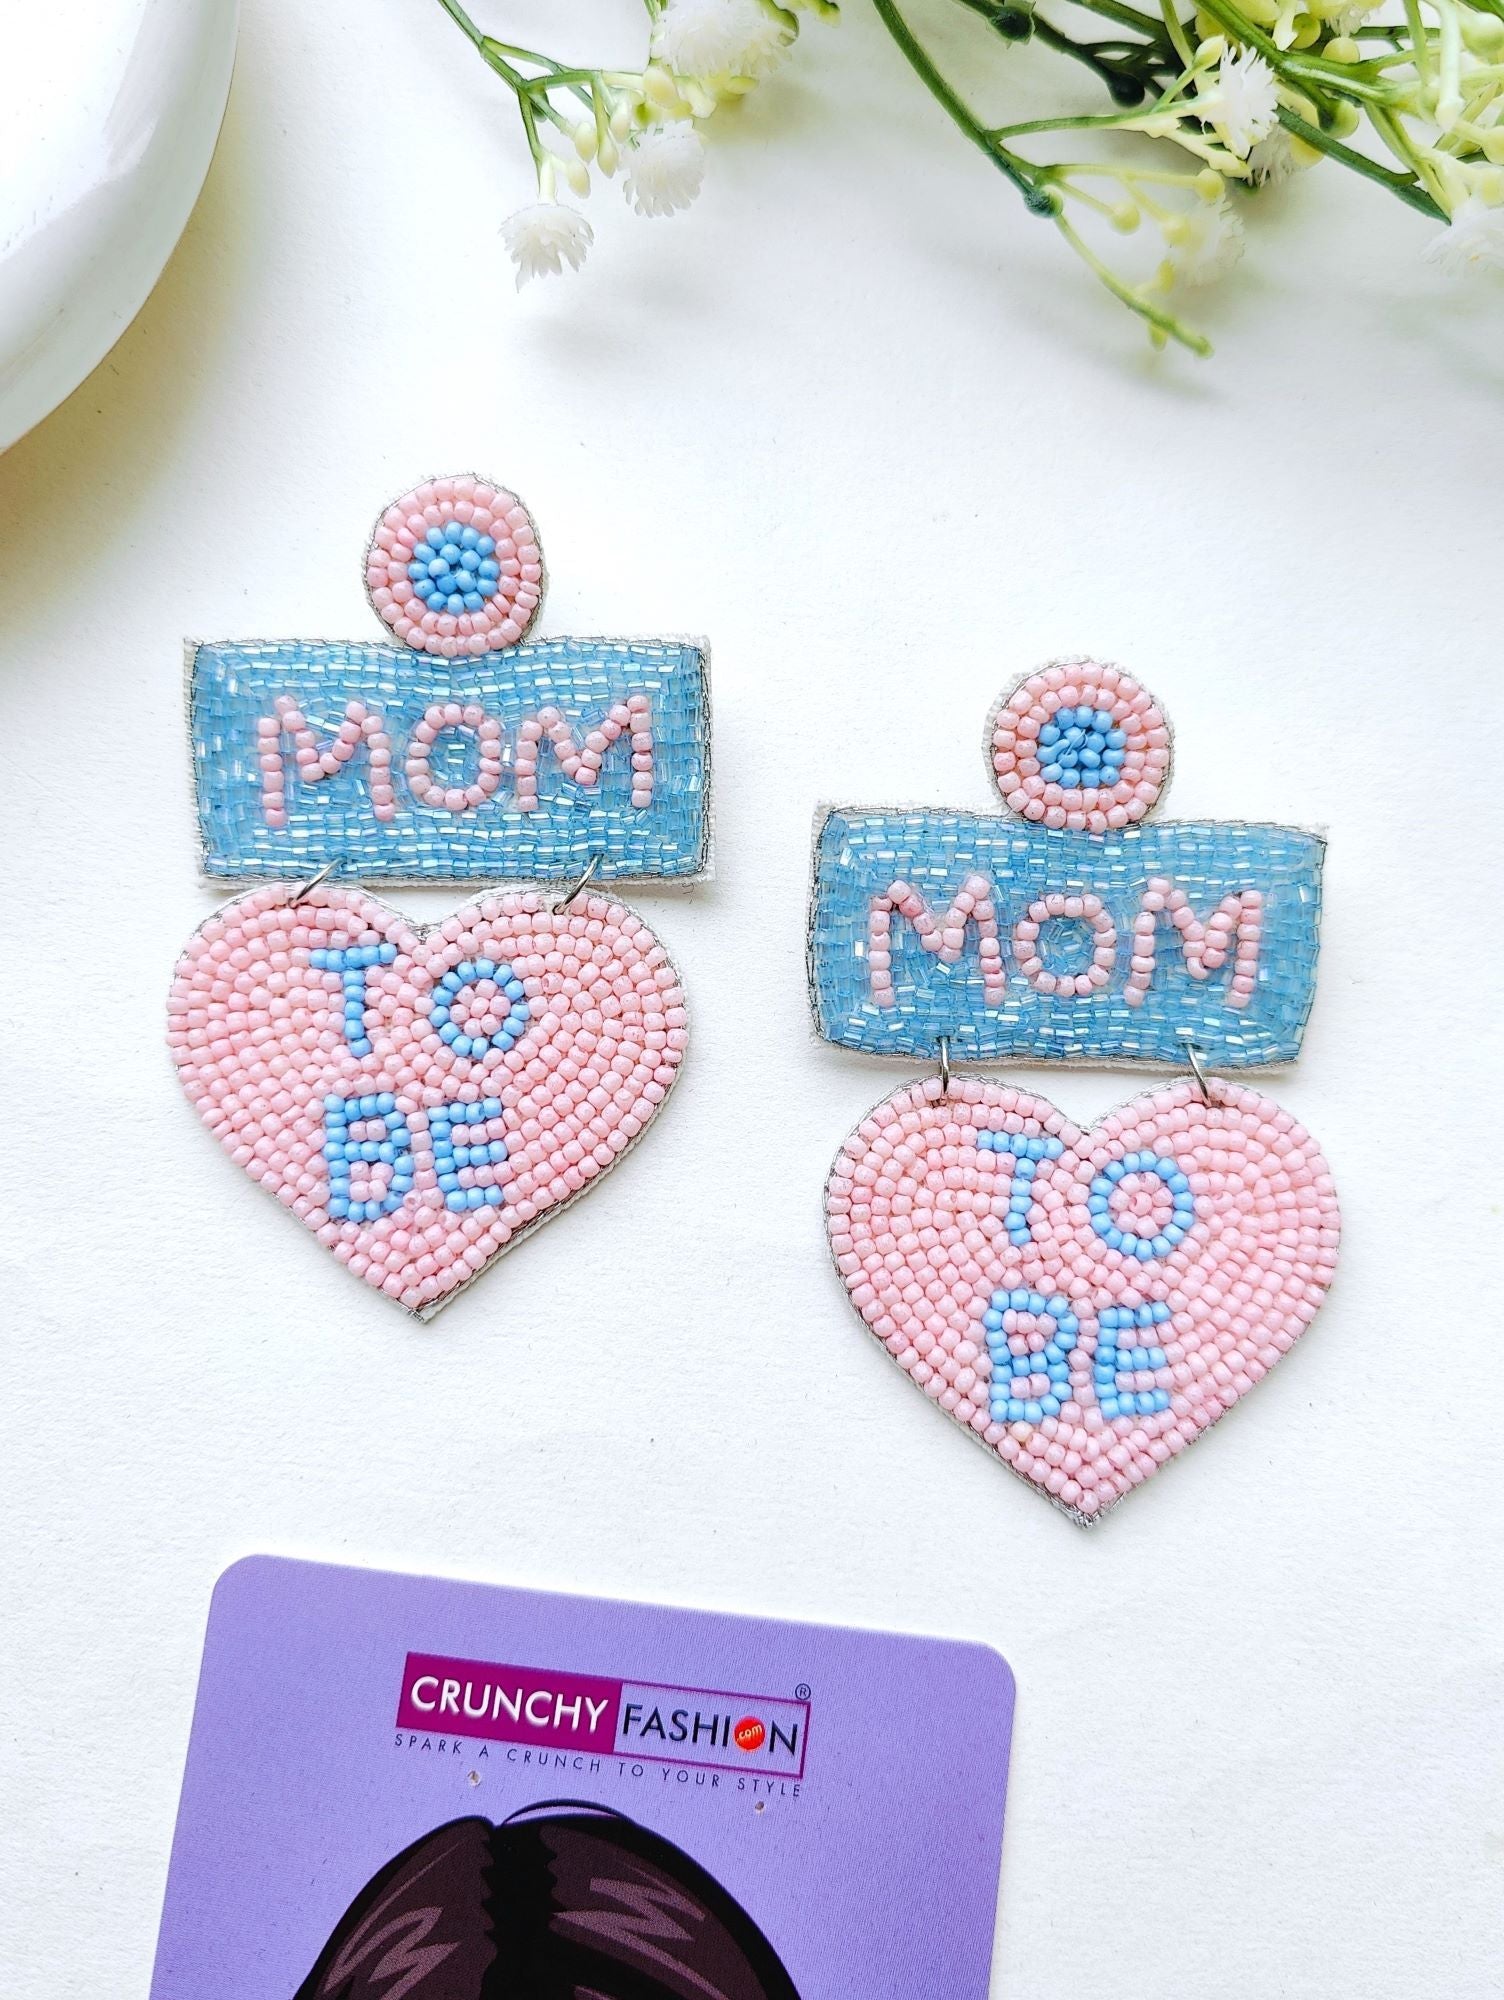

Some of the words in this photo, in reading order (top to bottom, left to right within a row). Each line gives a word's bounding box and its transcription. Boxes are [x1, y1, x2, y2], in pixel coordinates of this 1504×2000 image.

[257, 695, 652, 827] MOM
[310, 942, 532, 1059] TO
[868, 872, 1262, 1009] MOM
[323, 1091, 507, 1222] BE
[977, 1129, 1195, 1260] TO
[983, 1288, 1173, 1424] BE
[394, 1733, 463, 1755] SPARK
[478, 1744, 490, 1758] A
[506, 1748, 601, 1774] CRUNCH
[618, 1762, 644, 1777] TO
[662, 1768, 720, 1788] YOUR
[737, 1777, 801, 1798] STYLE
[410, 1675, 609, 1734] CRUNCHY
